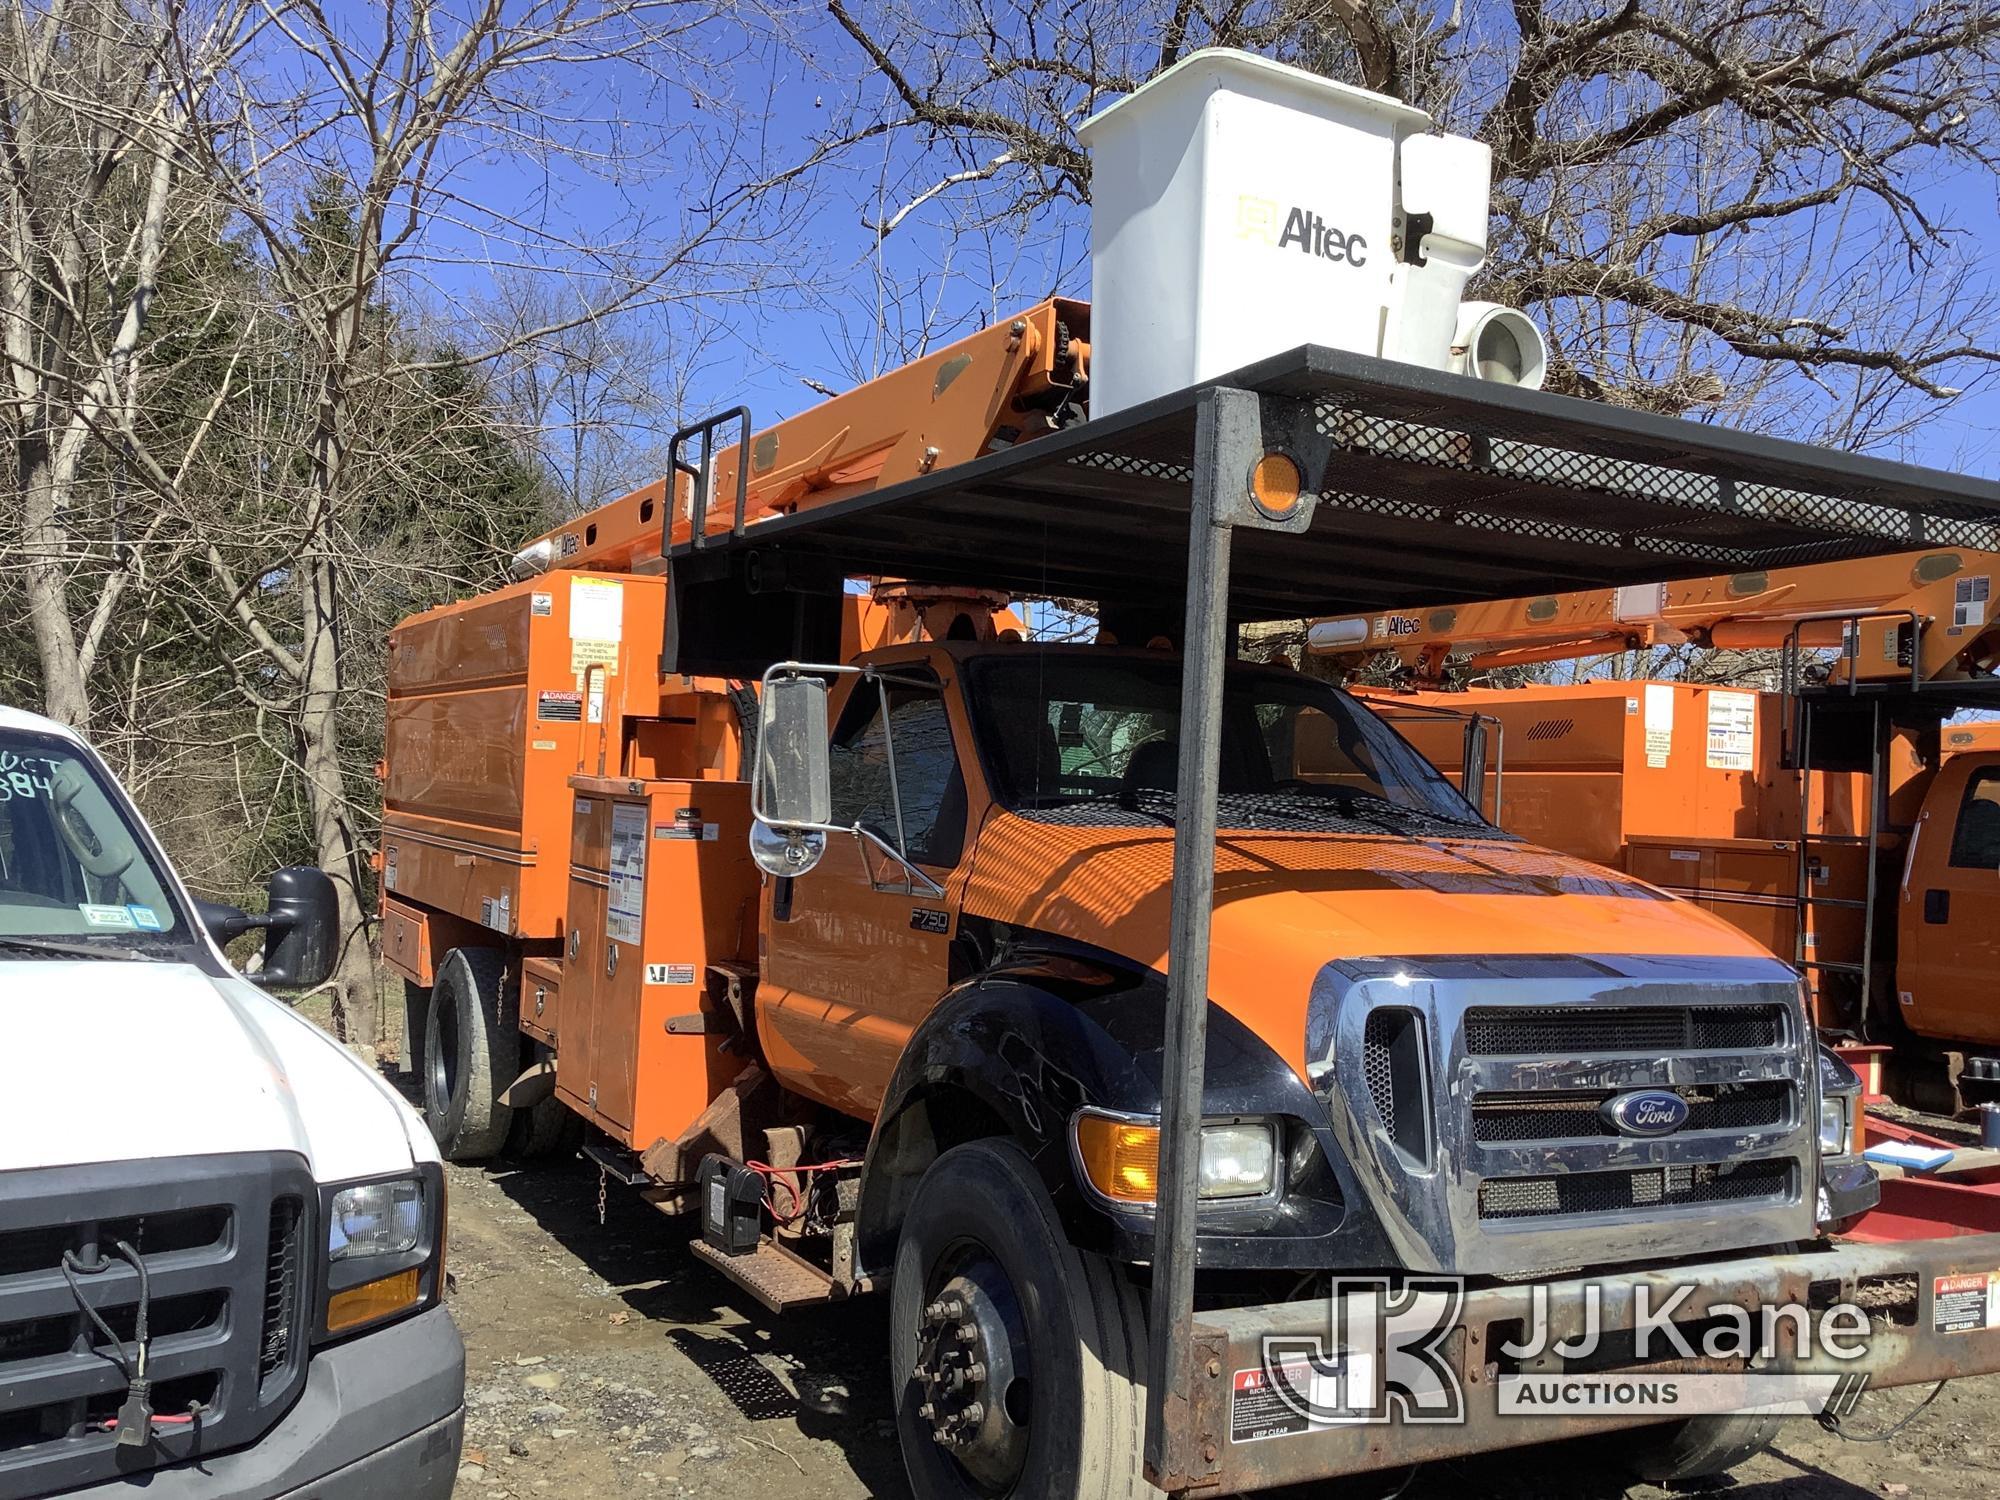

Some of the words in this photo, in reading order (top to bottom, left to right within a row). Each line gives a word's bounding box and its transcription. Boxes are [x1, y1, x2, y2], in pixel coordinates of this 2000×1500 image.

[1278, 207, 1368, 267] Altec
[1387, 616, 1420, 636] Altec
[550, 692, 583, 700] DANGER
[1635, 1099, 1676, 1124] Ford
[1950, 1277, 1983, 1290] DANGER
[1252, 1429, 1268, 1439] KEEP
[1268, 1426, 1289, 1436] CLEAR
